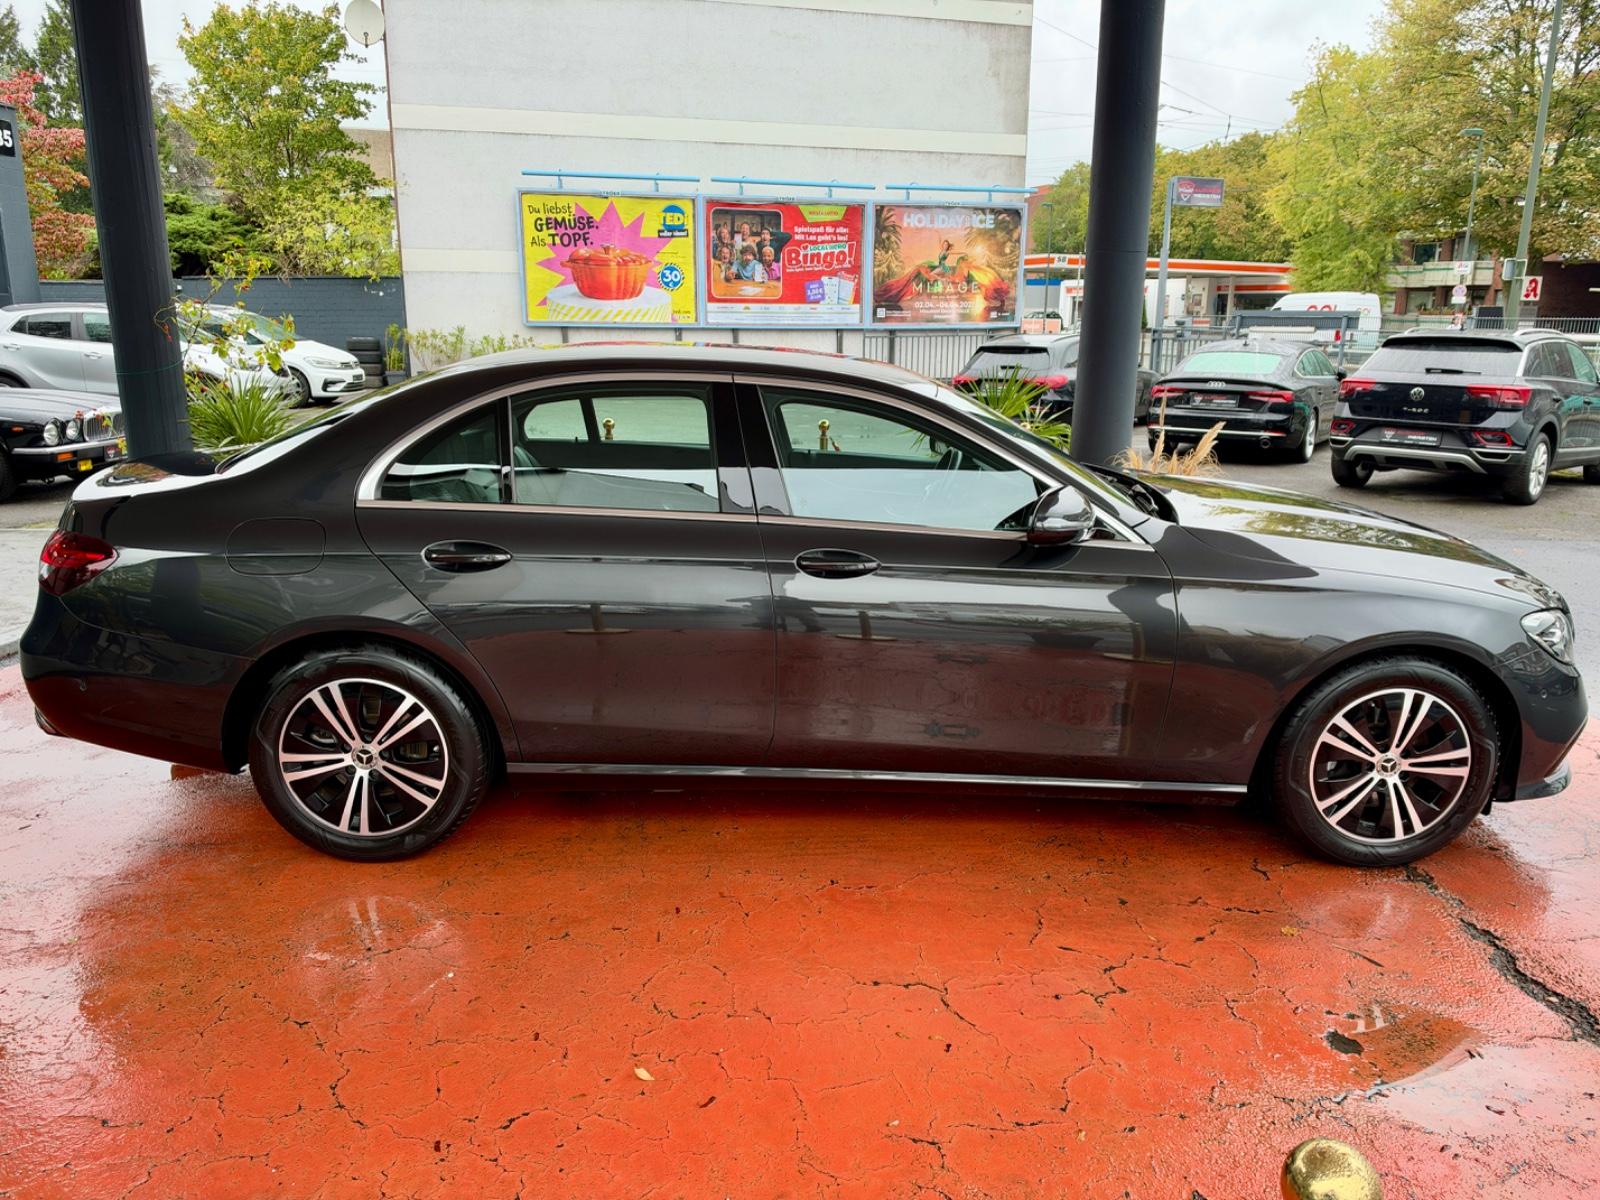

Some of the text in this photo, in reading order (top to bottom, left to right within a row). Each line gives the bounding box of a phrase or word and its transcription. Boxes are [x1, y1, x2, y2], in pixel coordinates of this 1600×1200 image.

[528, 201, 572, 215] Du liebst
[534, 213, 599, 232] GEMÜSE.
[903, 213, 963, 229] HOLIDAY
[971, 214, 995, 229] ICE
[530, 231, 594, 247] Als TOPF.
[785, 242, 857, 270] Bingo!
[663, 270, 681, 282] 30
[912, 281, 980, 294] MIRAGE
